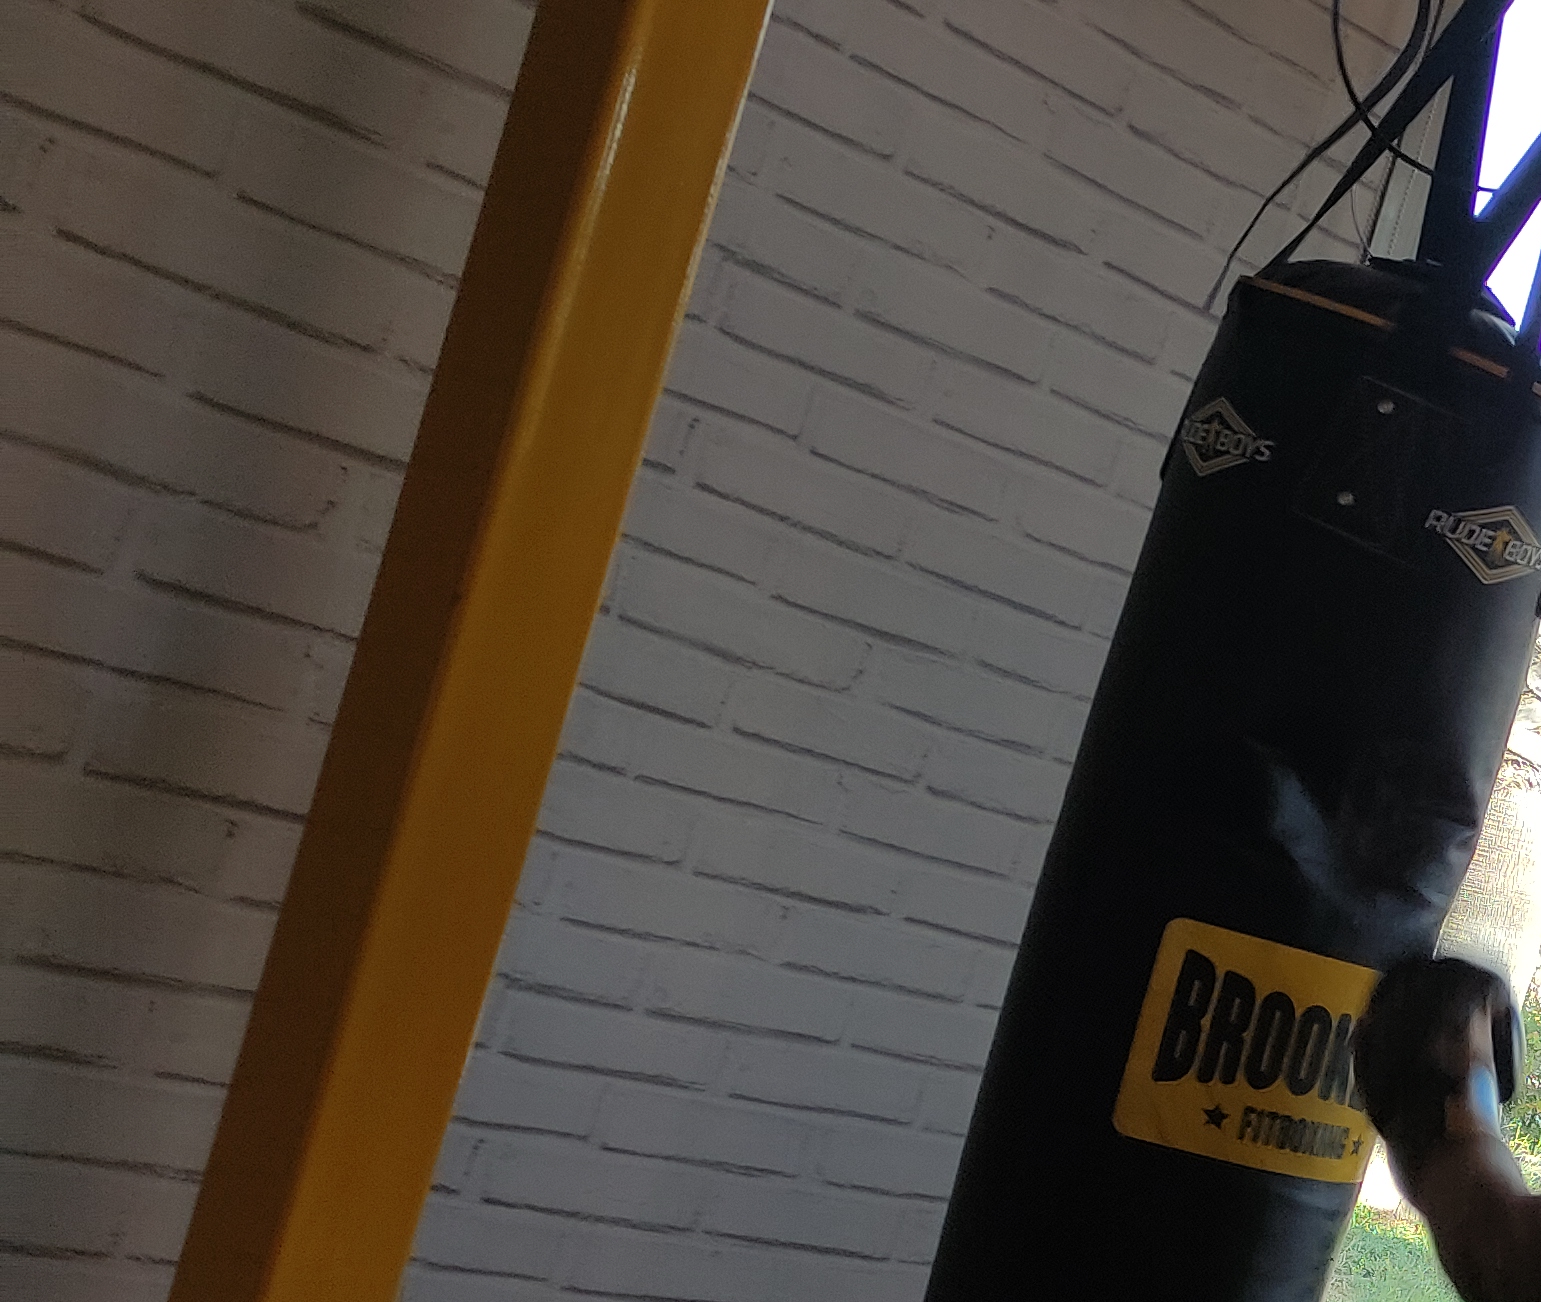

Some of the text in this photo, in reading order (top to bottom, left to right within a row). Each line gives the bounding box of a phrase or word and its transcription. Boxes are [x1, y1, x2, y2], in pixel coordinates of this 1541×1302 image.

[1215, 428, 1276, 462] BOYS
[1425, 509, 1496, 552] RUDE
[1151, 948, 1362, 1109] BROOK
